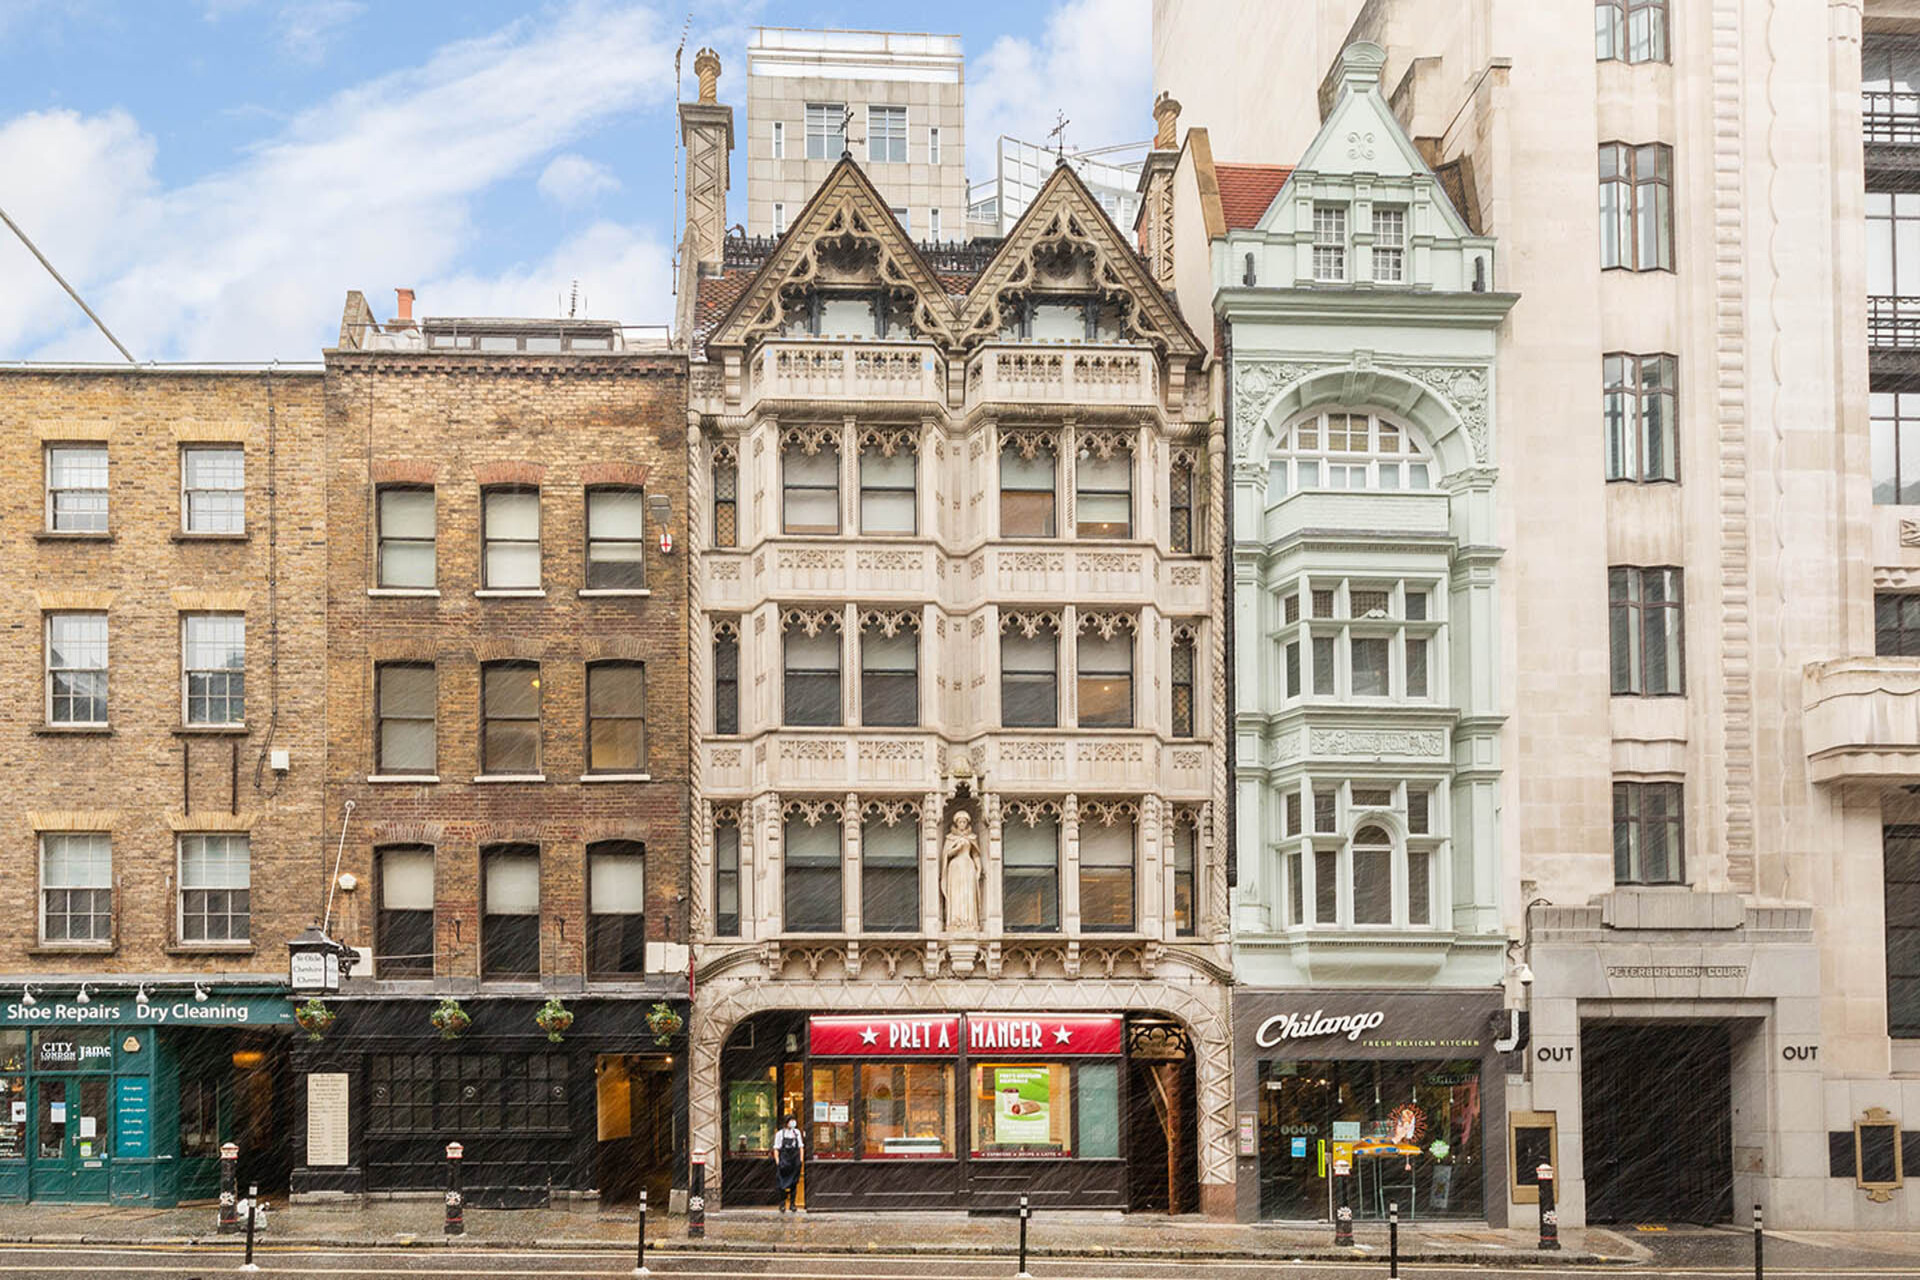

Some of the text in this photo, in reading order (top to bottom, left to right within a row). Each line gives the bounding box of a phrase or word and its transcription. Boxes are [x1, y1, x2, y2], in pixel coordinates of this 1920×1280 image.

[1607, 966, 1748, 978] PETERBOROUGH COURT
[7, 1003, 121, 1022] Shoe Repairs
[136, 1003, 249, 1022] Dry Cleaning
[889, 1021, 1043, 1049] PRET A MANGER
[1255, 1009, 1385, 1048] Chilango
[42, 1042, 74, 1052] CITY
[1362, 1039, 1481, 1047] FRESH MEXICAN KITCHEN
[1537, 1047, 1574, 1062] OUT
[1782, 1046, 1819, 1061] OUT
